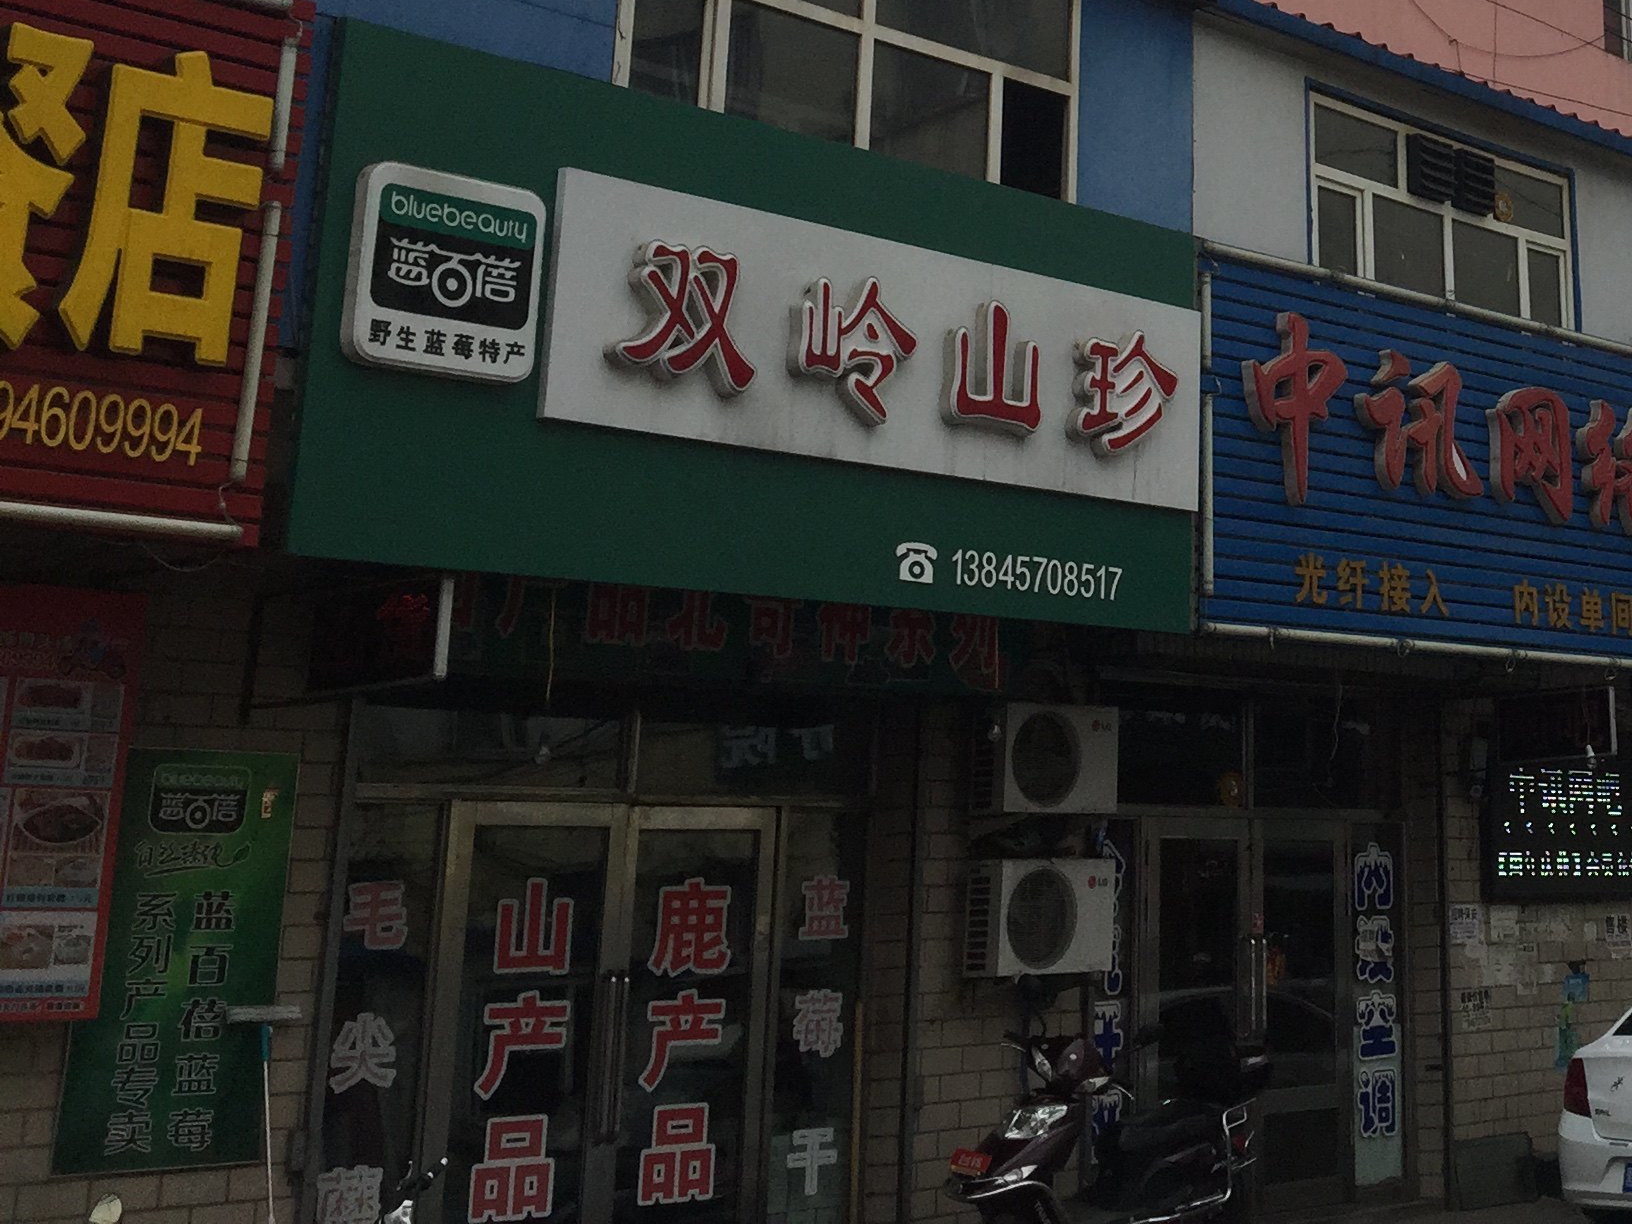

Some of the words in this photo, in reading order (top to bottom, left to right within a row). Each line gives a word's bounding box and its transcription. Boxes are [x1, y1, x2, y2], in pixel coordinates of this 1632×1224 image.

[390, 190, 528, 244] bluebeauty
[369, 319, 526, 365] 野生蓝莓特产
[612, 238, 1180, 458] 双岭山珍
[950, 549, 1123, 601] 13845708517
[1294, 552, 1449, 617] 光纤接入
[104, 891, 178, 1155] 系列产品专卖
[167, 891, 235, 1152] 蓝百倍蓝莓
[469, 877, 574, 1223] 山产品
[637, 877, 733, 1206] 鹿产品
[786, 876, 850, 1196] 蓝莓干
